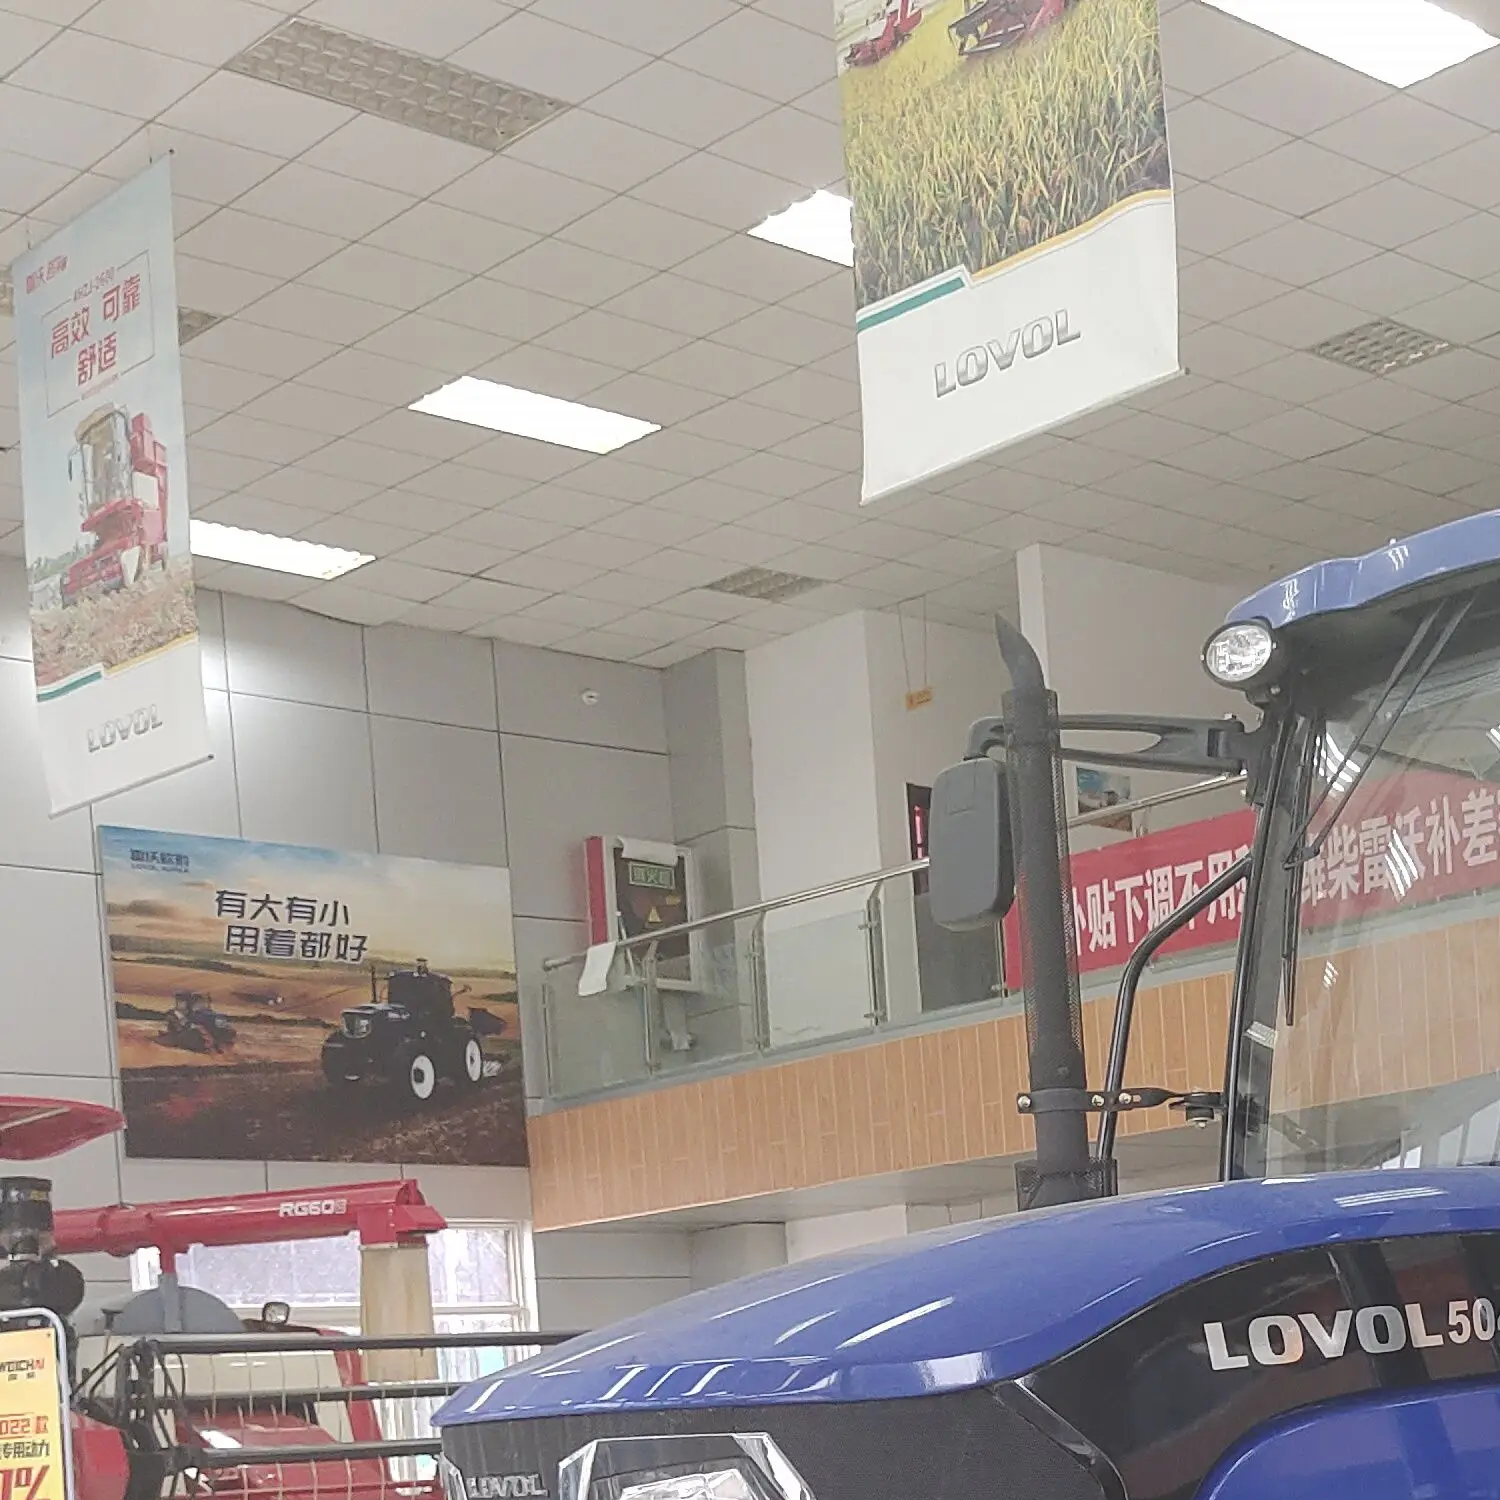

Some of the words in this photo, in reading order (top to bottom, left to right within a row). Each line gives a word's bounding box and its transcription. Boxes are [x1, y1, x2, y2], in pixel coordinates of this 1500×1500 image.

[51, 306, 90, 359] 高效
[103, 273, 140, 323] 可靠
[77, 331, 117, 385] 舒适
[935, 309, 1080, 397] LOVOL
[87, 703, 162, 752] LOVOL
[215, 889, 350, 926] 有大有小
[226, 925, 368, 961] 用着都好
[1203, 1303, 1444, 1371] LOVOL
